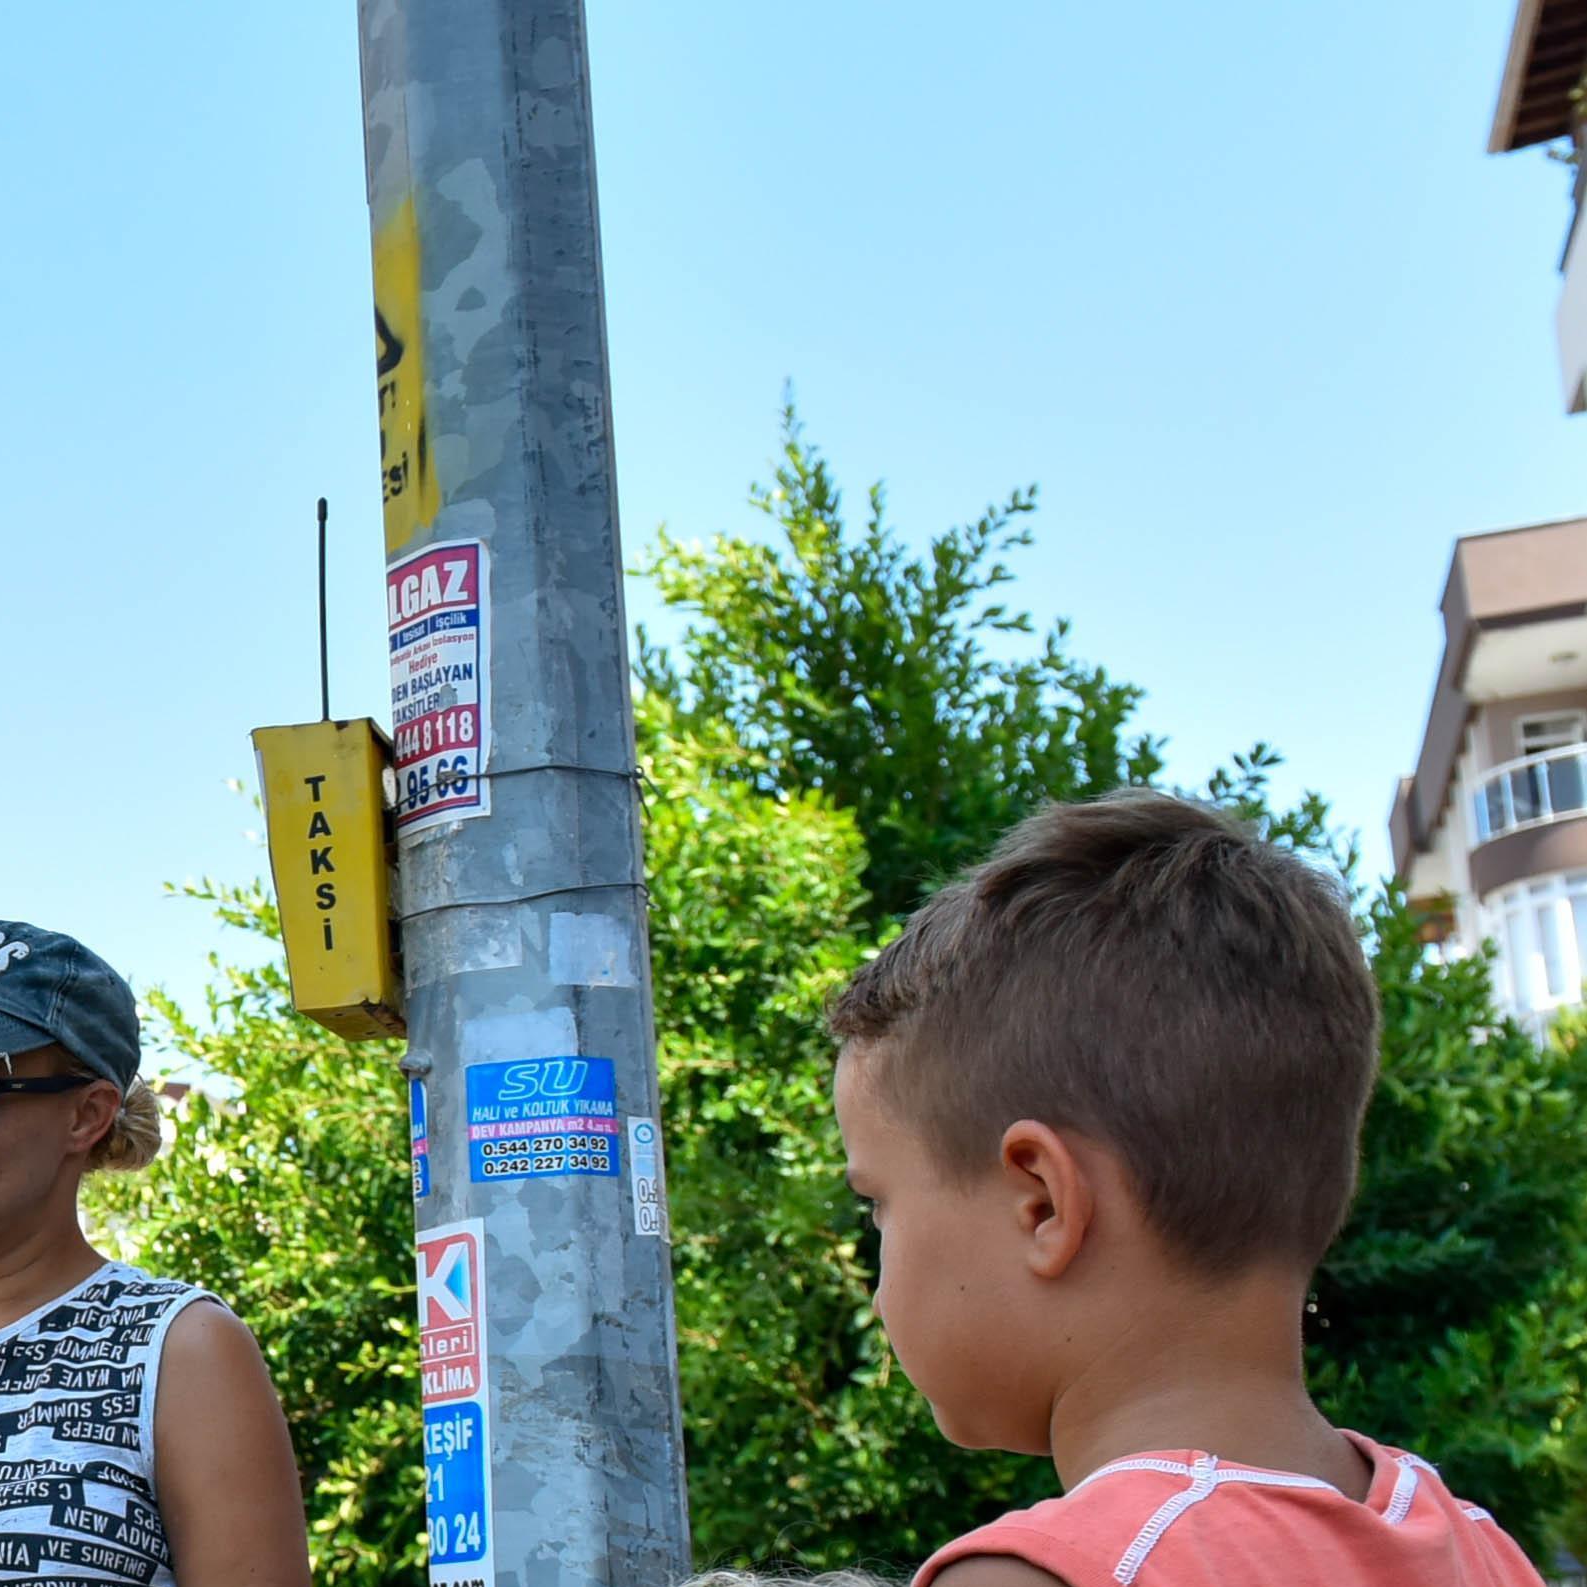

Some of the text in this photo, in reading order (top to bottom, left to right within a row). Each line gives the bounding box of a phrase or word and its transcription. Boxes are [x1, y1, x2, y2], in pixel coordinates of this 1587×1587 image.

[411, 663, 472, 696] BAŞLAYAN
[304, 775, 336, 951] TAKSİ
[499, 1061, 587, 1100] SU
[523, 1099, 570, 1118] KOLTUK
[472, 1125, 495, 1139] DEV
[499, 1119, 563, 1137] KAMPANYA
[534, 1137, 564, 1152] 270
[569, 1137, 587, 1150] 34
[590, 1137, 608, 1151] 92
[534, 1156, 564, 1170] 227
[569, 1155, 587, 1169] 34
[591, 1155, 609, 1170] 92
[59, 1368, 109, 1387] WAVE
[62, 1421, 115, 1442] DEEPS
[64, 1506, 109, 1533] NEW
[454, 1511, 481, 1554] 24
[81, 1546, 147, 1577] SURFING
